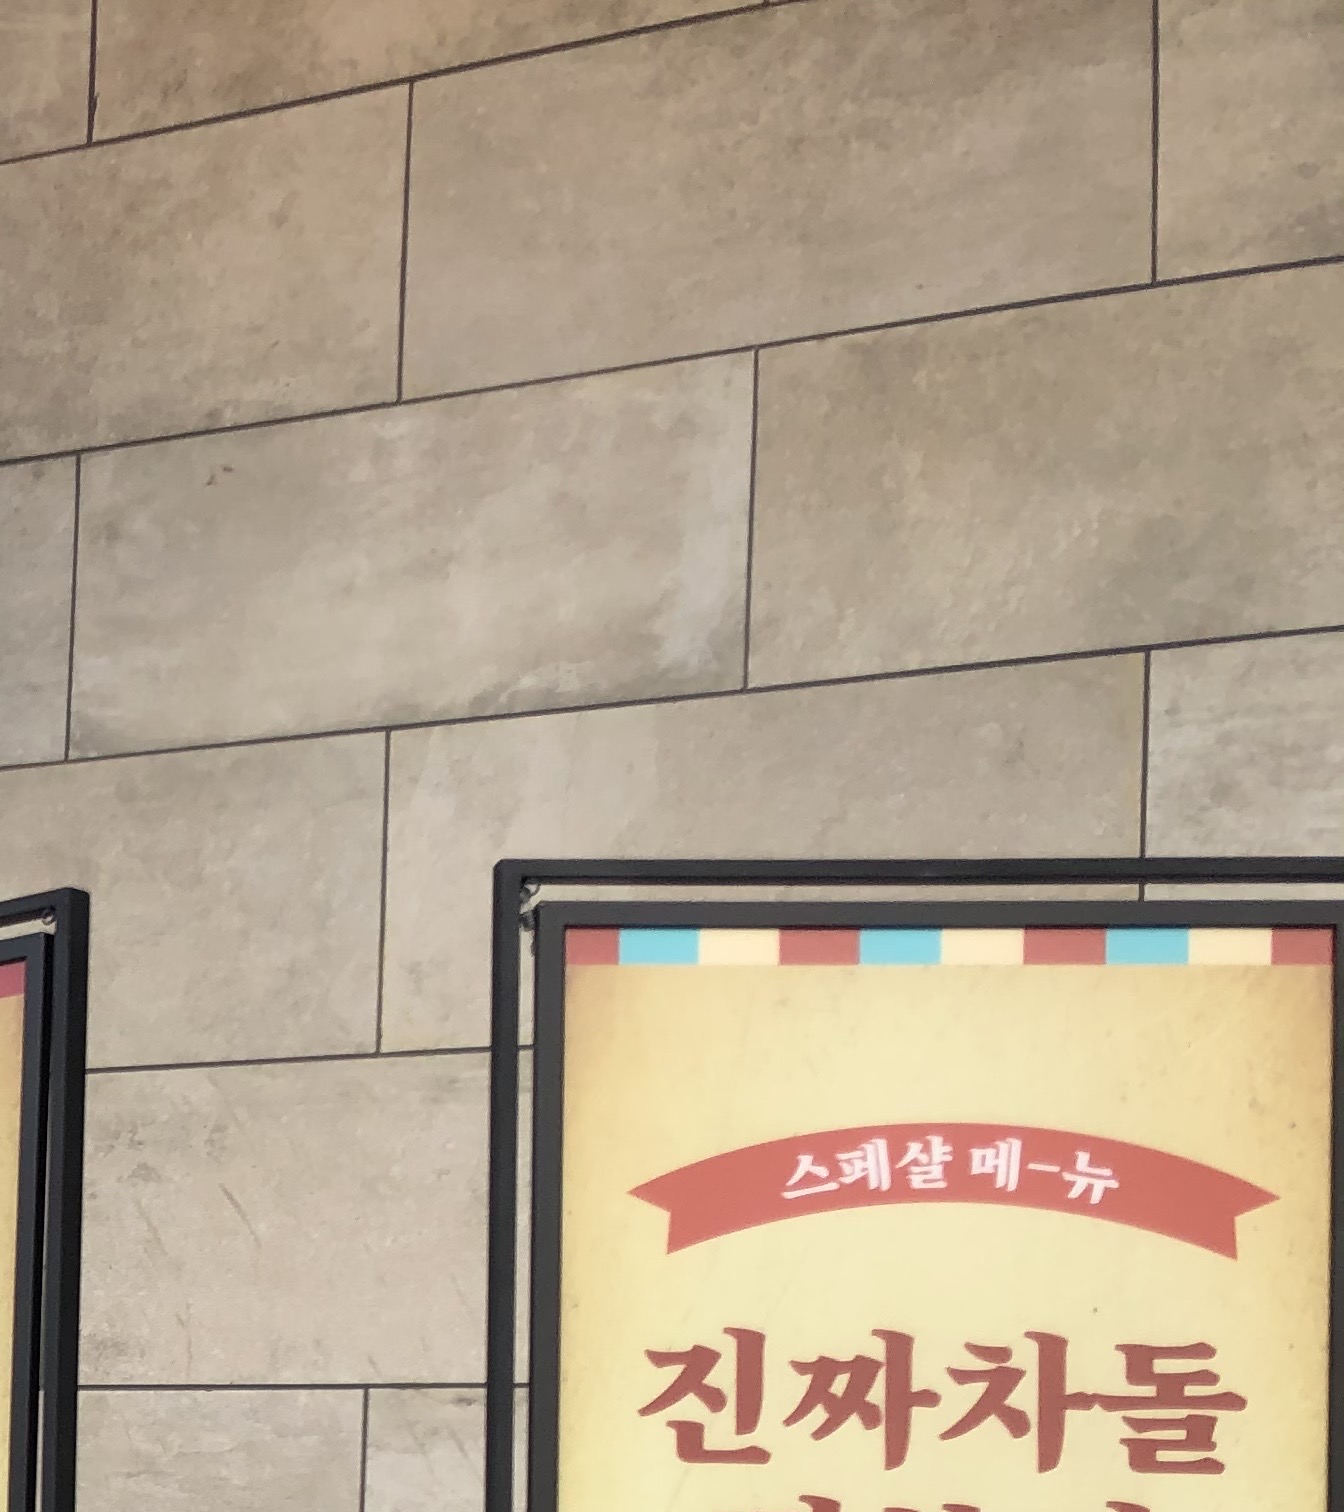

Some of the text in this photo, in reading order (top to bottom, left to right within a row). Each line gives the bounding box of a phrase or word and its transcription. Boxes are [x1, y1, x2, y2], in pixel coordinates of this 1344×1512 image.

[781, 1134, 1121, 1206] 스페샬 메-뉴
[637, 1327, 1249, 1475] 진짜차돌
